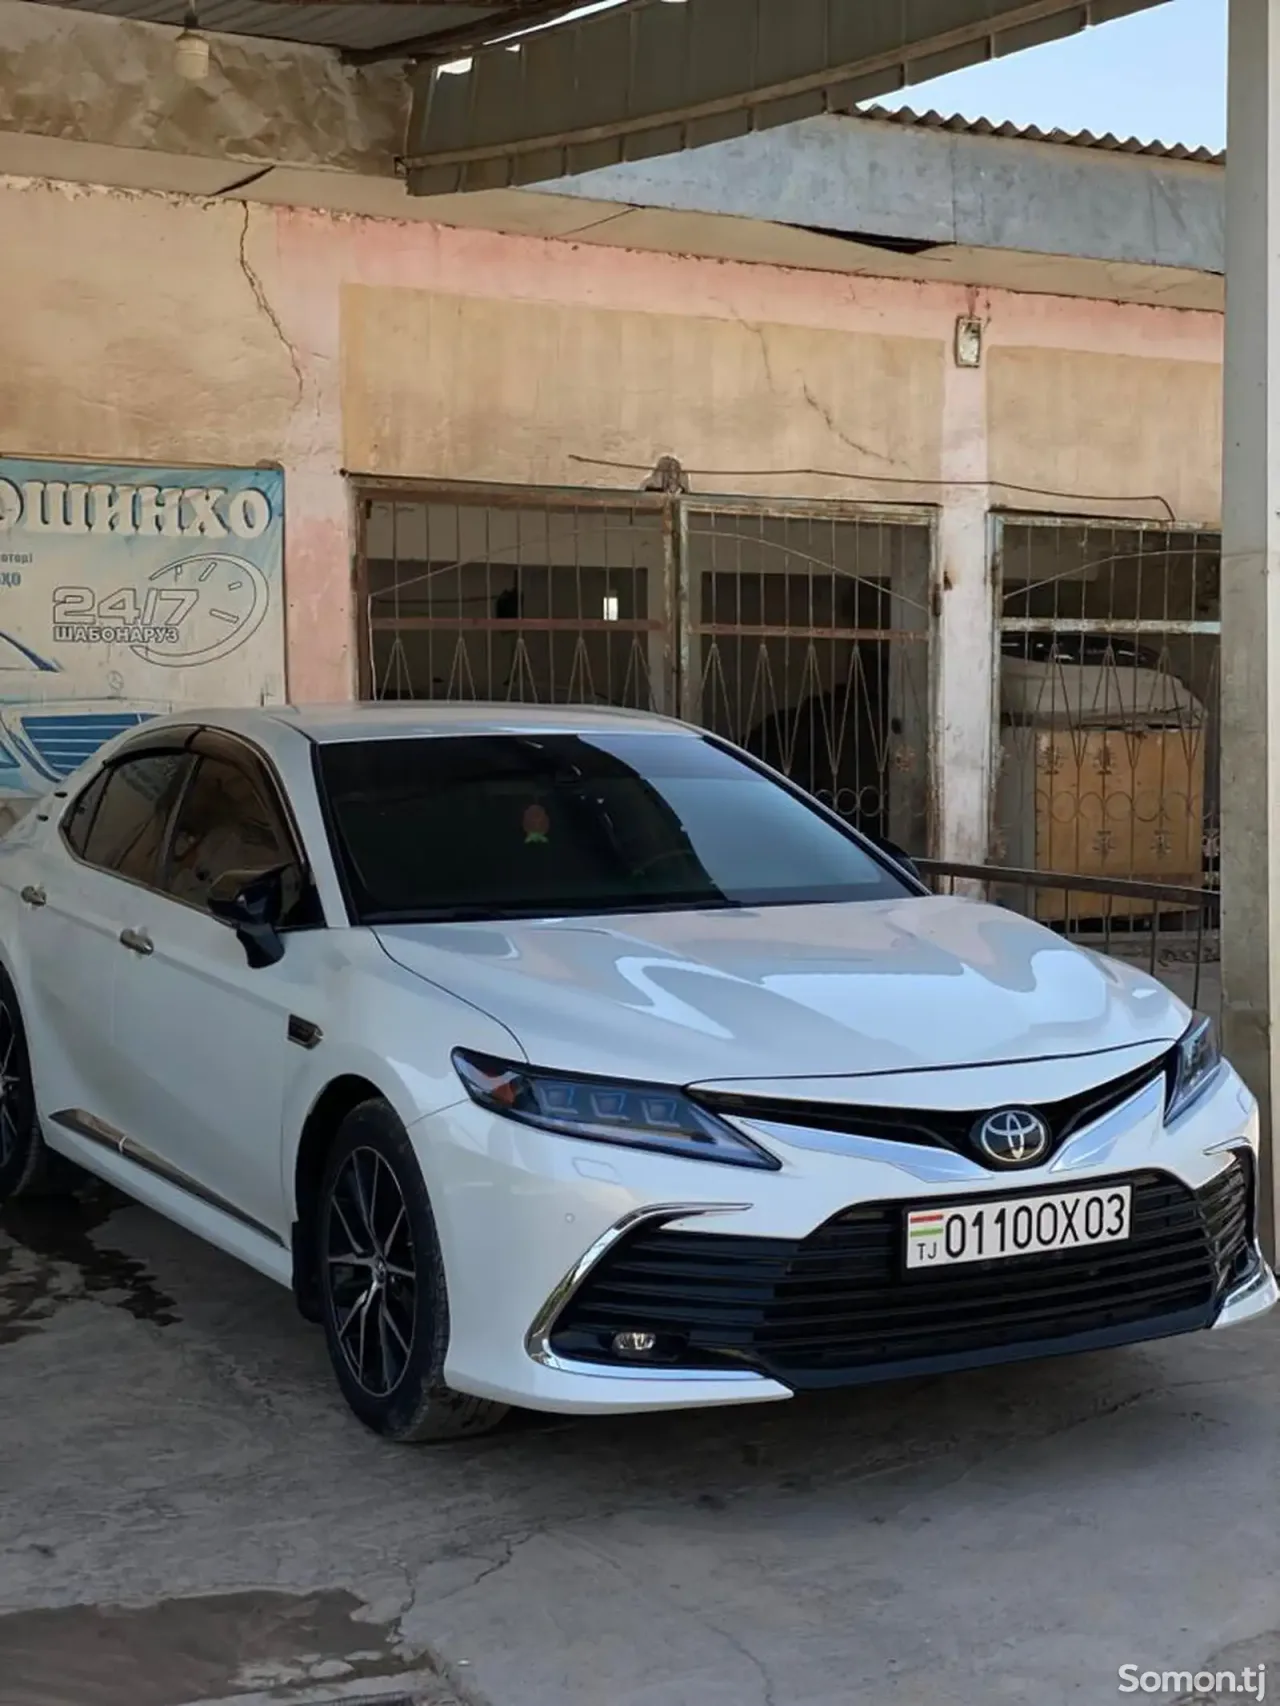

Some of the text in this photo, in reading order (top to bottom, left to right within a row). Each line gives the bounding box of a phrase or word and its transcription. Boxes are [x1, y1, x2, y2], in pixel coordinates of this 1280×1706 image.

[52, 586, 200, 626] 24/7
[53, 625, 180, 643] ШАБОНАРУЗ
[917, 1242, 937, 1260] TJ
